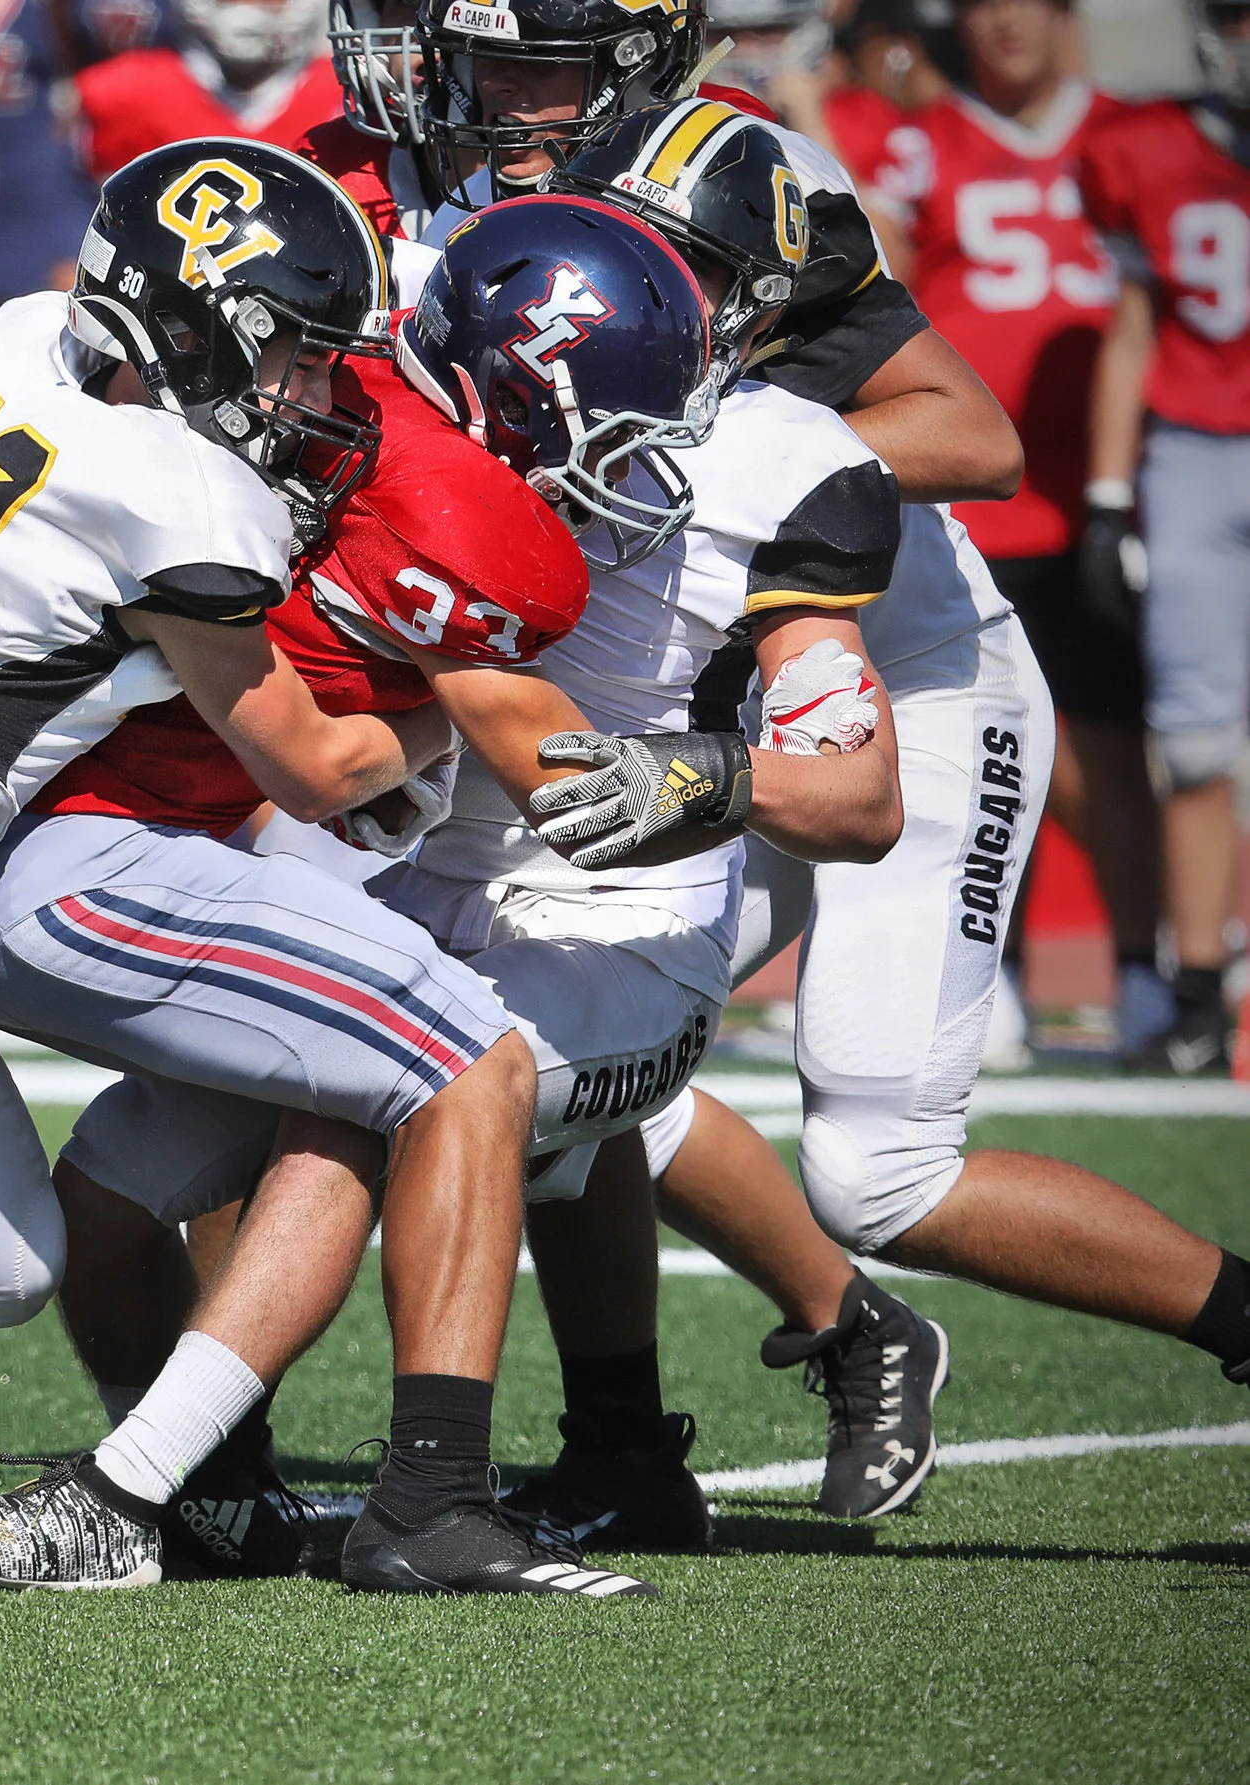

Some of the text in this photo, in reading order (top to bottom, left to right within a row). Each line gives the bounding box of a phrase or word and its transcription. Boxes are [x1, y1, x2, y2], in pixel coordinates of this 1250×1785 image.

[464, 10, 491, 28] CAPO
[636, 181, 668, 203] CAPO
[118, 265, 145, 300] 30
[656, 778, 714, 815] adidas
[960, 726, 1022, 946] COUGARS
[562, 1014, 707, 1125] COUGARS
[179, 1500, 242, 1560] adidas
